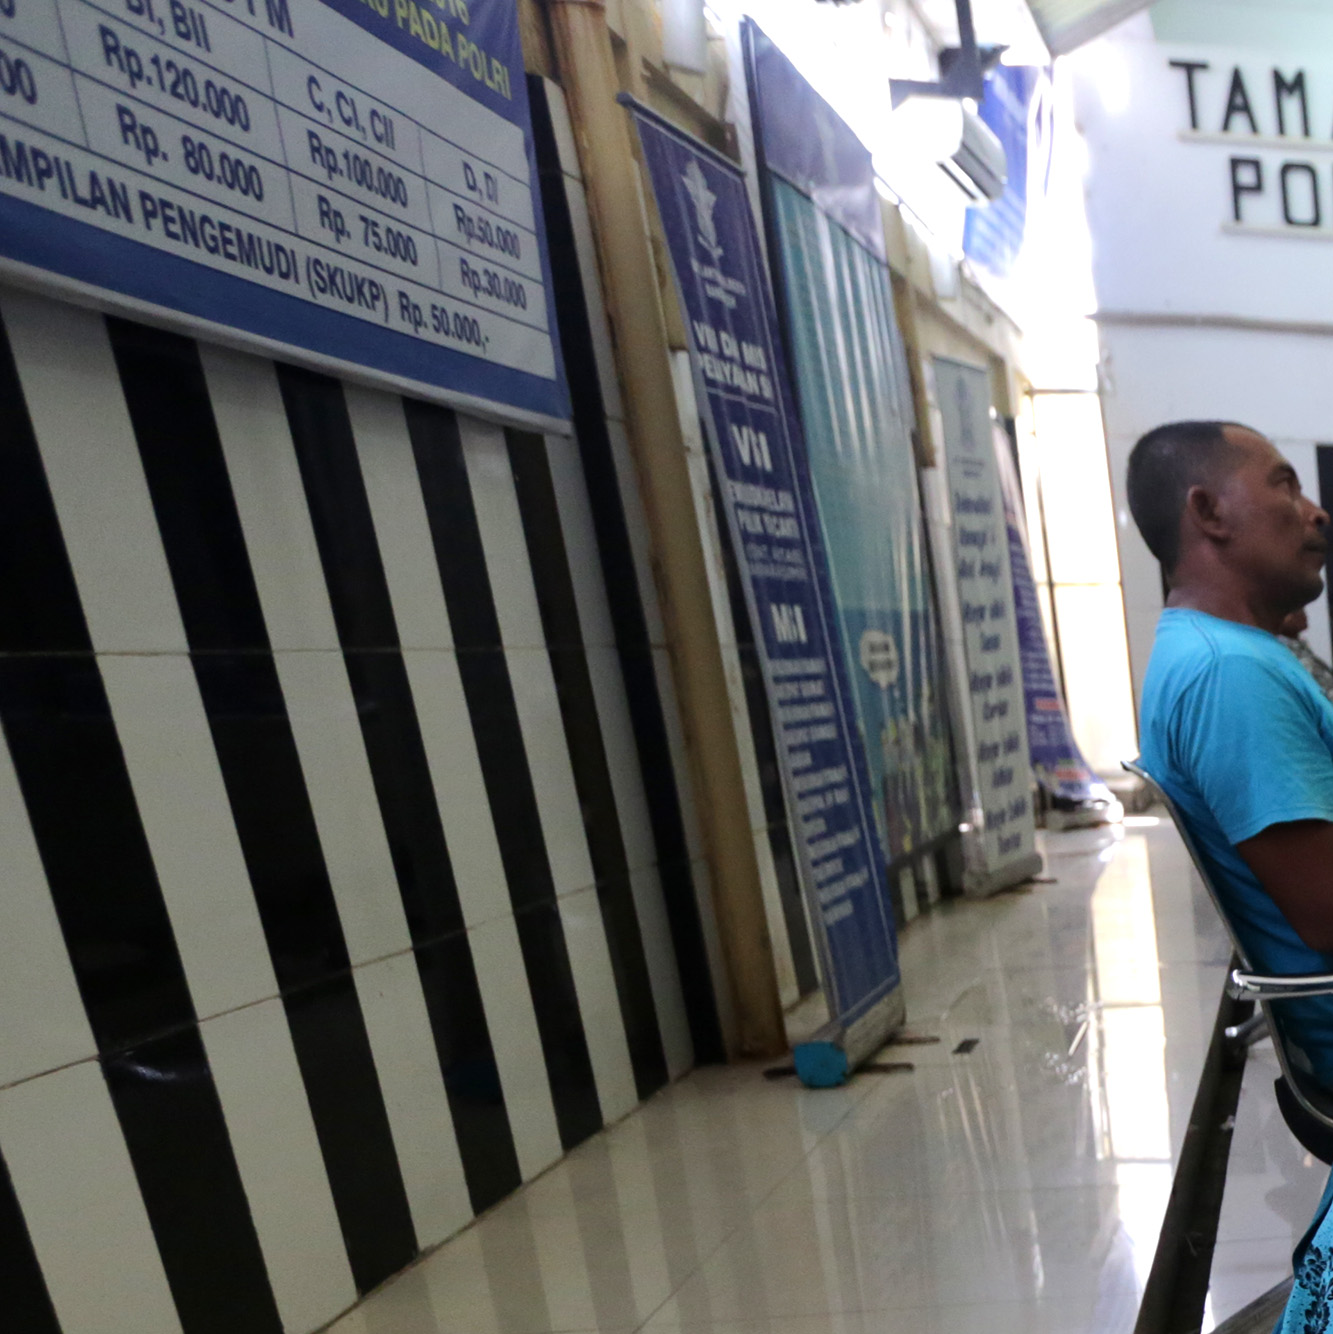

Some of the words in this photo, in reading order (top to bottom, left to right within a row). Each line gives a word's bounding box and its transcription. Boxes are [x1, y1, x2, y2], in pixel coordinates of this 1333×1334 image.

[98, 23, 250, 132] Rp.120.000
[394, 0, 457, 62] PADA
[457, 31, 513, 101] POLRI
[116, 102, 169, 166] Rp.
[182, 134, 264, 202] 80.000
[306, 128, 408, 209] Rp.100.000
[369, 108, 396, 151] CII
[138, 190, 300, 285] PENGEMUDI
[306, 255, 390, 324] (SKUKP)
[359, 214, 418, 267] 75.000
[452, 203, 521, 261] Rp.50.000
[459, 256, 527, 311] Rp.30.000
